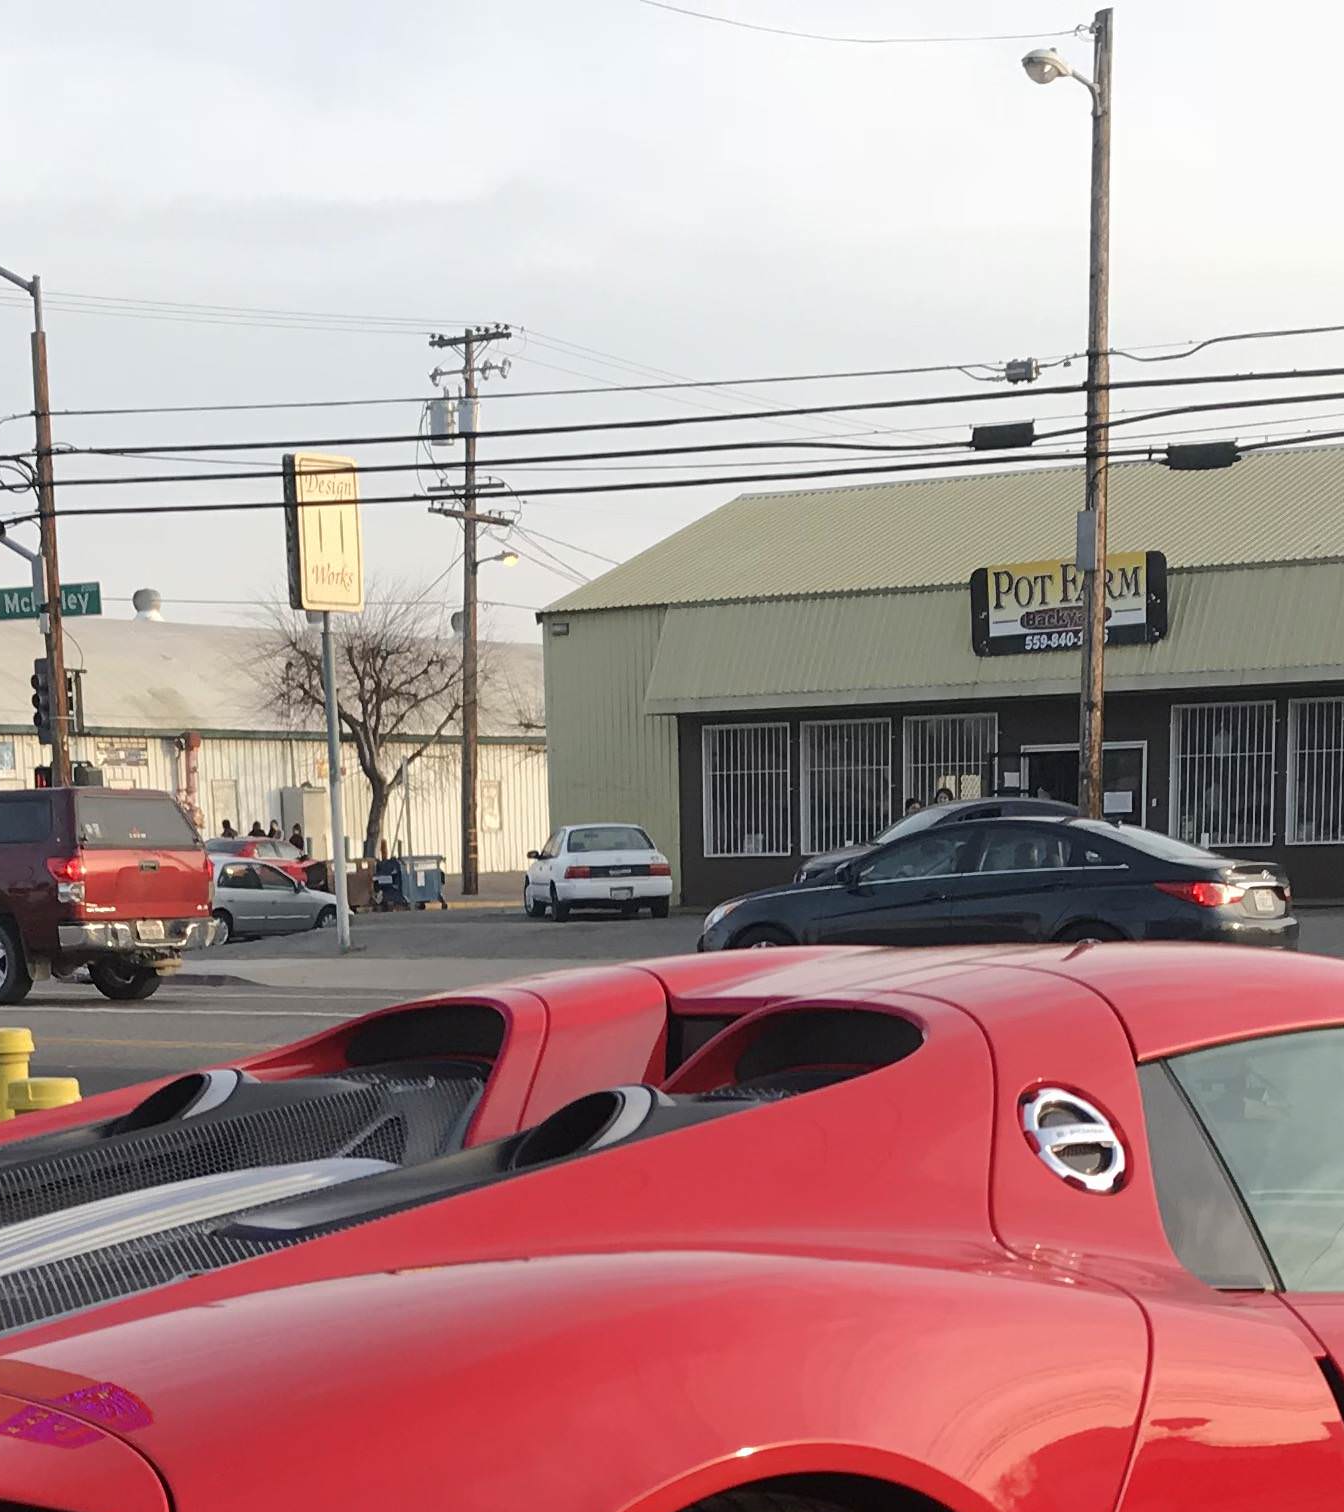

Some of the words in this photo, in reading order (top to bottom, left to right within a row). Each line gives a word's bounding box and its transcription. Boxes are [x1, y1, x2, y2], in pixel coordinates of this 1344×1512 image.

[306, 472, 353, 503] Design
[312, 563, 354, 592] Works
[993, 569, 1053, 610] POT
[4, 590, 89, 614] Mcley
[1024, 608, 1086, 628] Backya
[1024, 629, 1109, 650] 559-840-1
